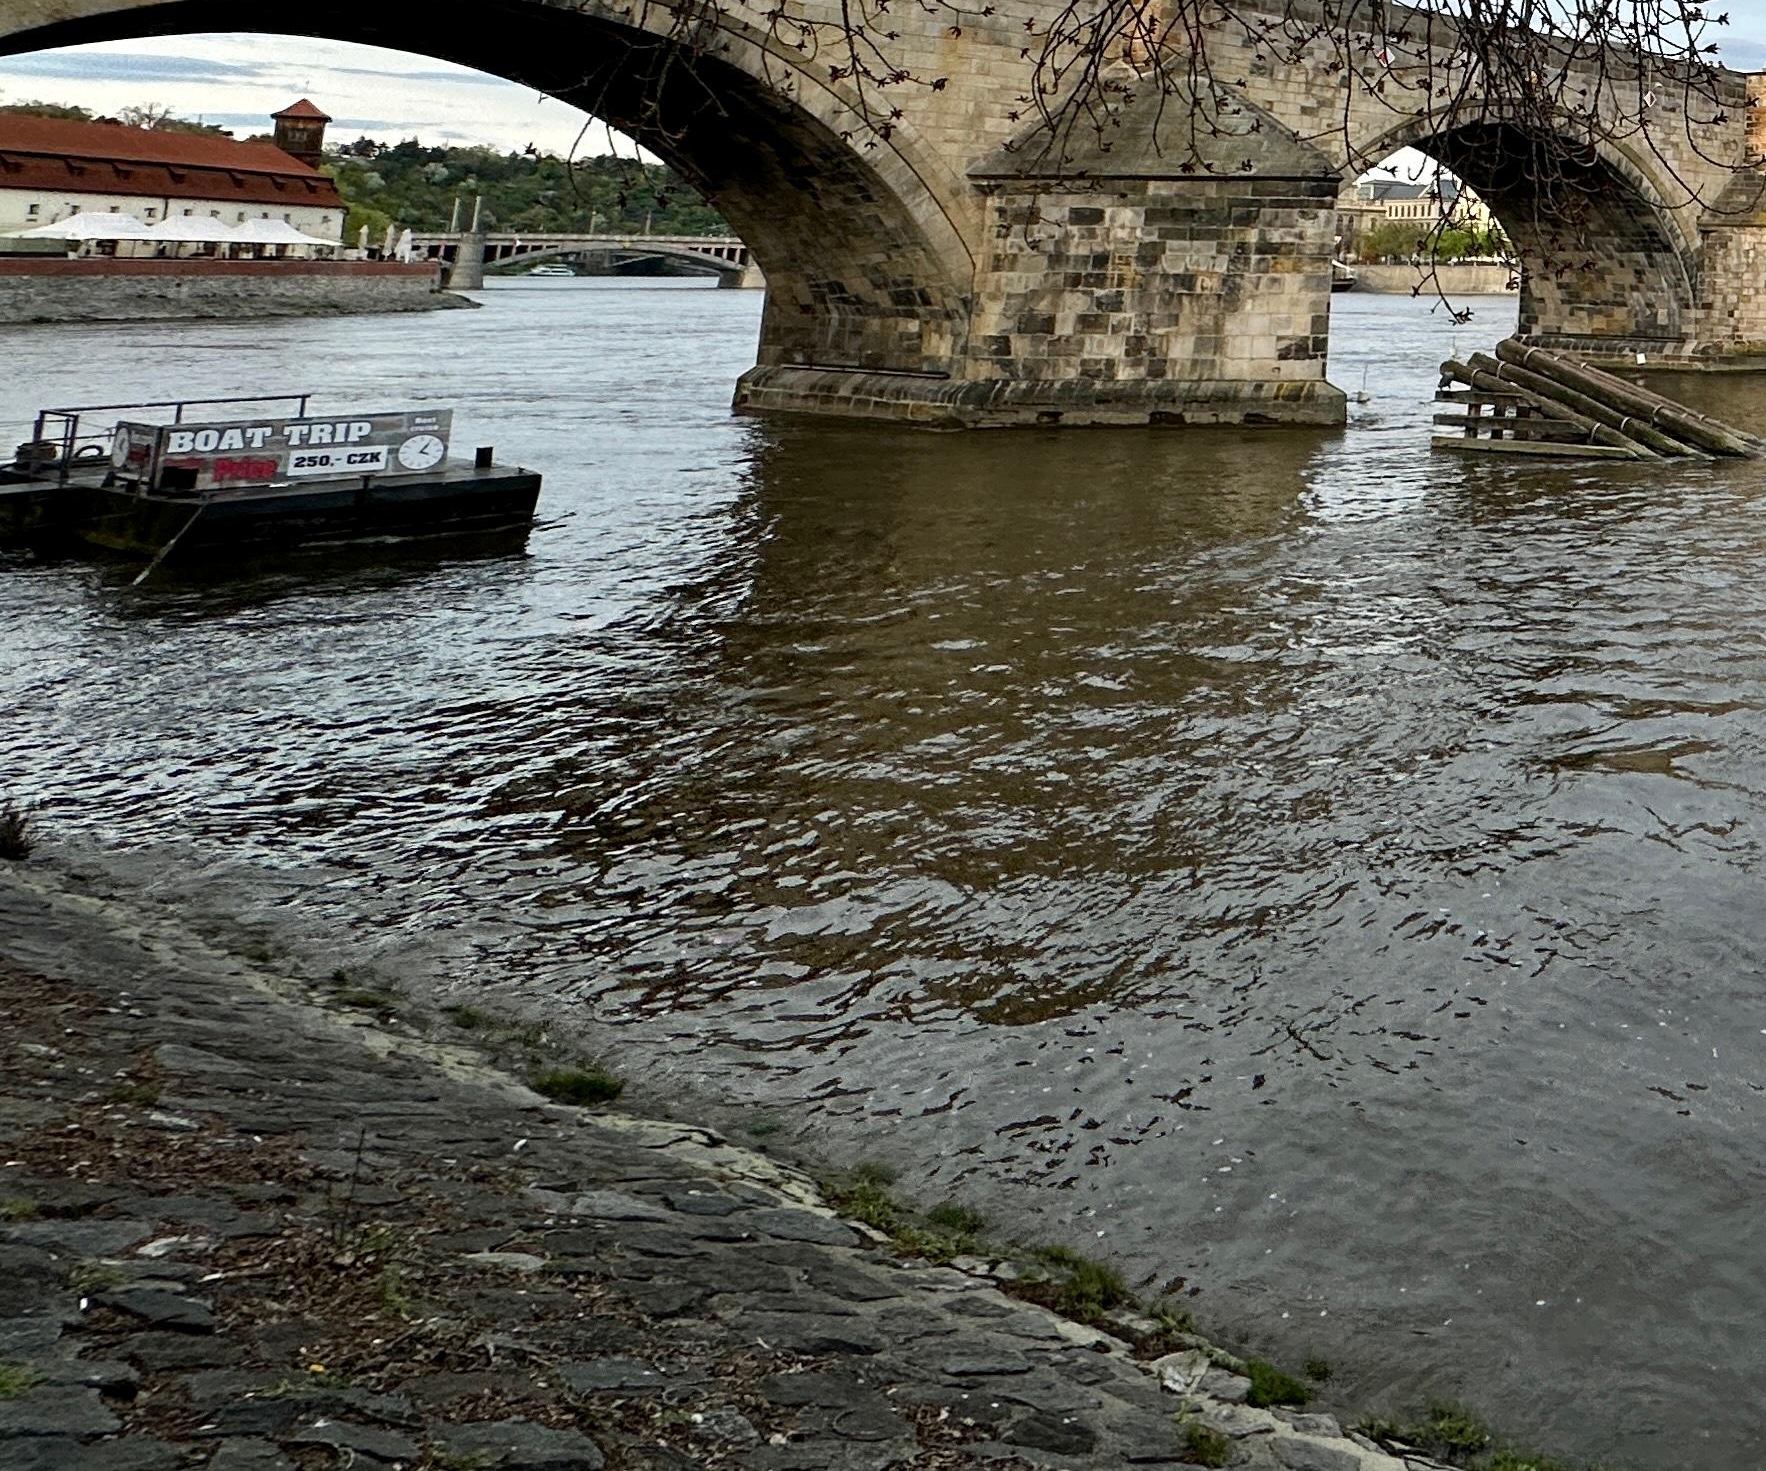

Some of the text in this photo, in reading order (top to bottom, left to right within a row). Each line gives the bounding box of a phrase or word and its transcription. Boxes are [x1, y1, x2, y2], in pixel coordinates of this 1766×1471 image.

[167, 426, 273, 454] BOAT
[283, 422, 371, 445] TRIP
[347, 452, 381, 464] CZK
